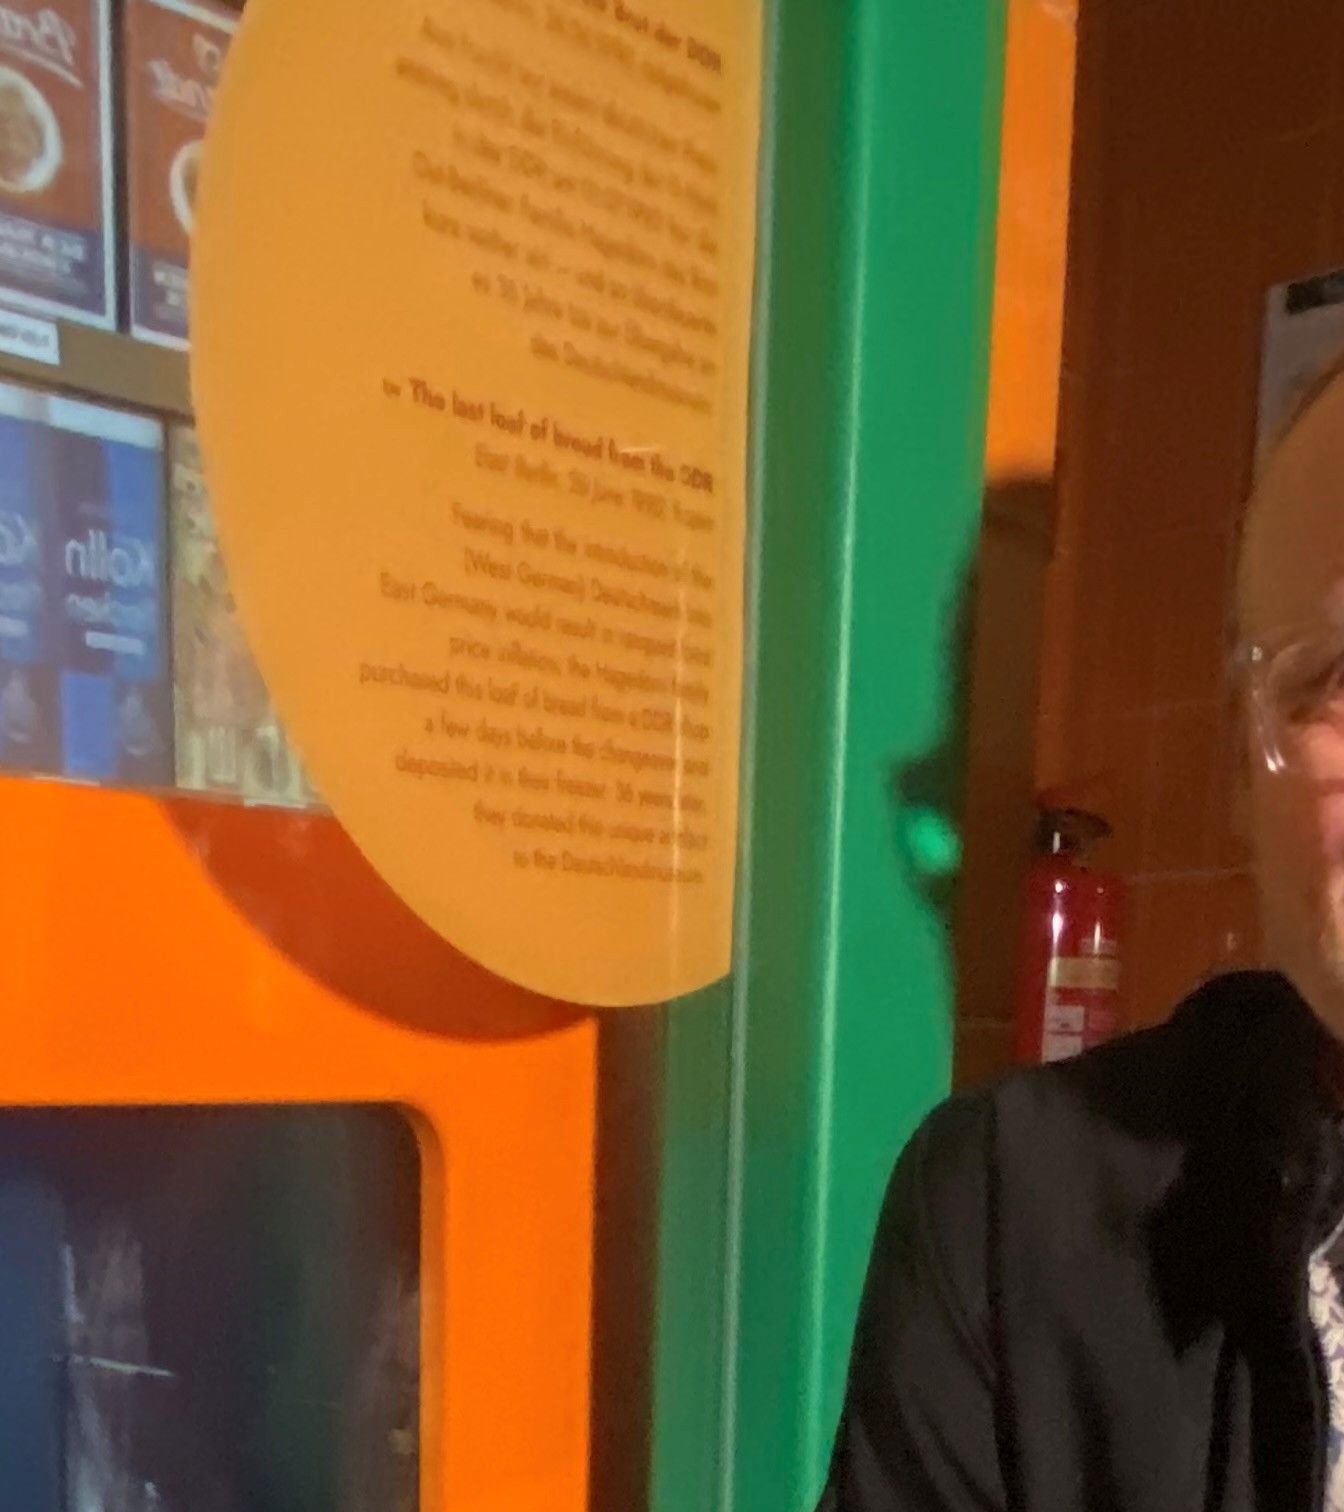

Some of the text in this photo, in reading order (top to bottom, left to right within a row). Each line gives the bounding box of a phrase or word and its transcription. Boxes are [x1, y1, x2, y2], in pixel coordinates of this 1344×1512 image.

[407, 376, 446, 412] The
[452, 389, 485, 421] last
[490, 400, 526, 436] loaf
[530, 416, 549, 441] of
[553, 421, 603, 460] bread
[650, 452, 676, 483] the
[378, 569, 417, 601] East
